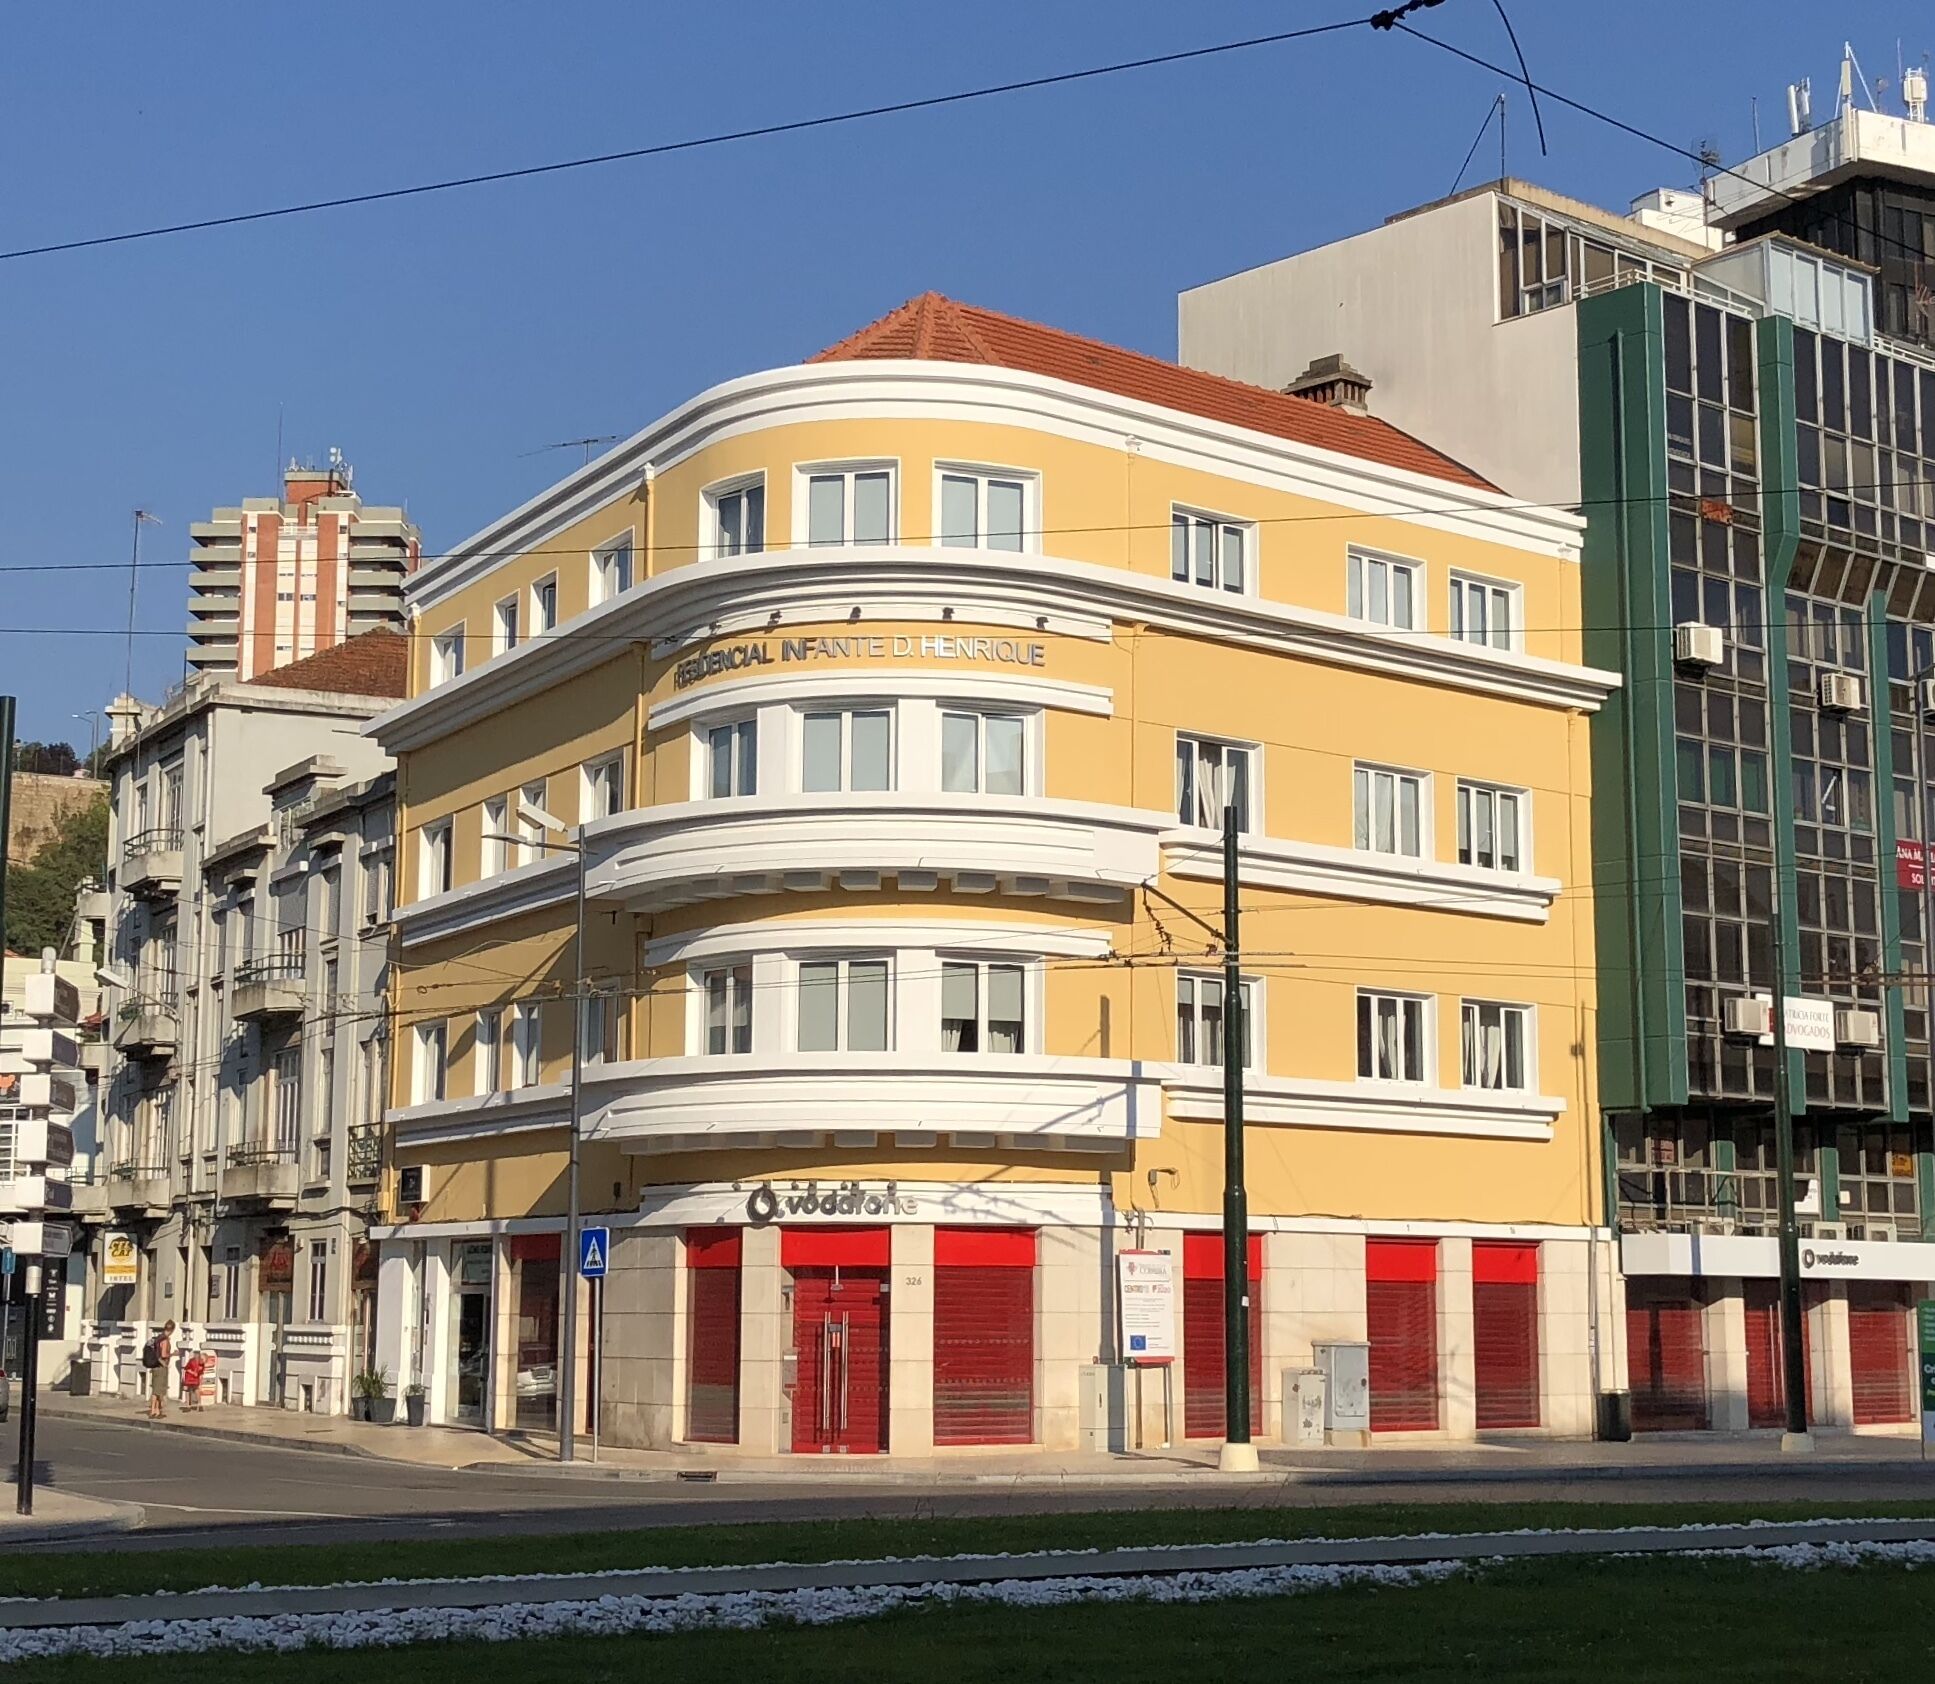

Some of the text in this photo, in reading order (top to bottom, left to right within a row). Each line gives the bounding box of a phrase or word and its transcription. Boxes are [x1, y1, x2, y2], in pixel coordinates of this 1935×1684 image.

[673, 636, 1046, 692] RESIDENCIAL INFANTE D. HENRIQUE
[1786, 1023, 1831, 1039] DVOGADOS
[785, 1189, 918, 1216] vodafone
[1816, 1251, 1859, 1266] vodafone
[905, 1276, 922, 1286] 326
